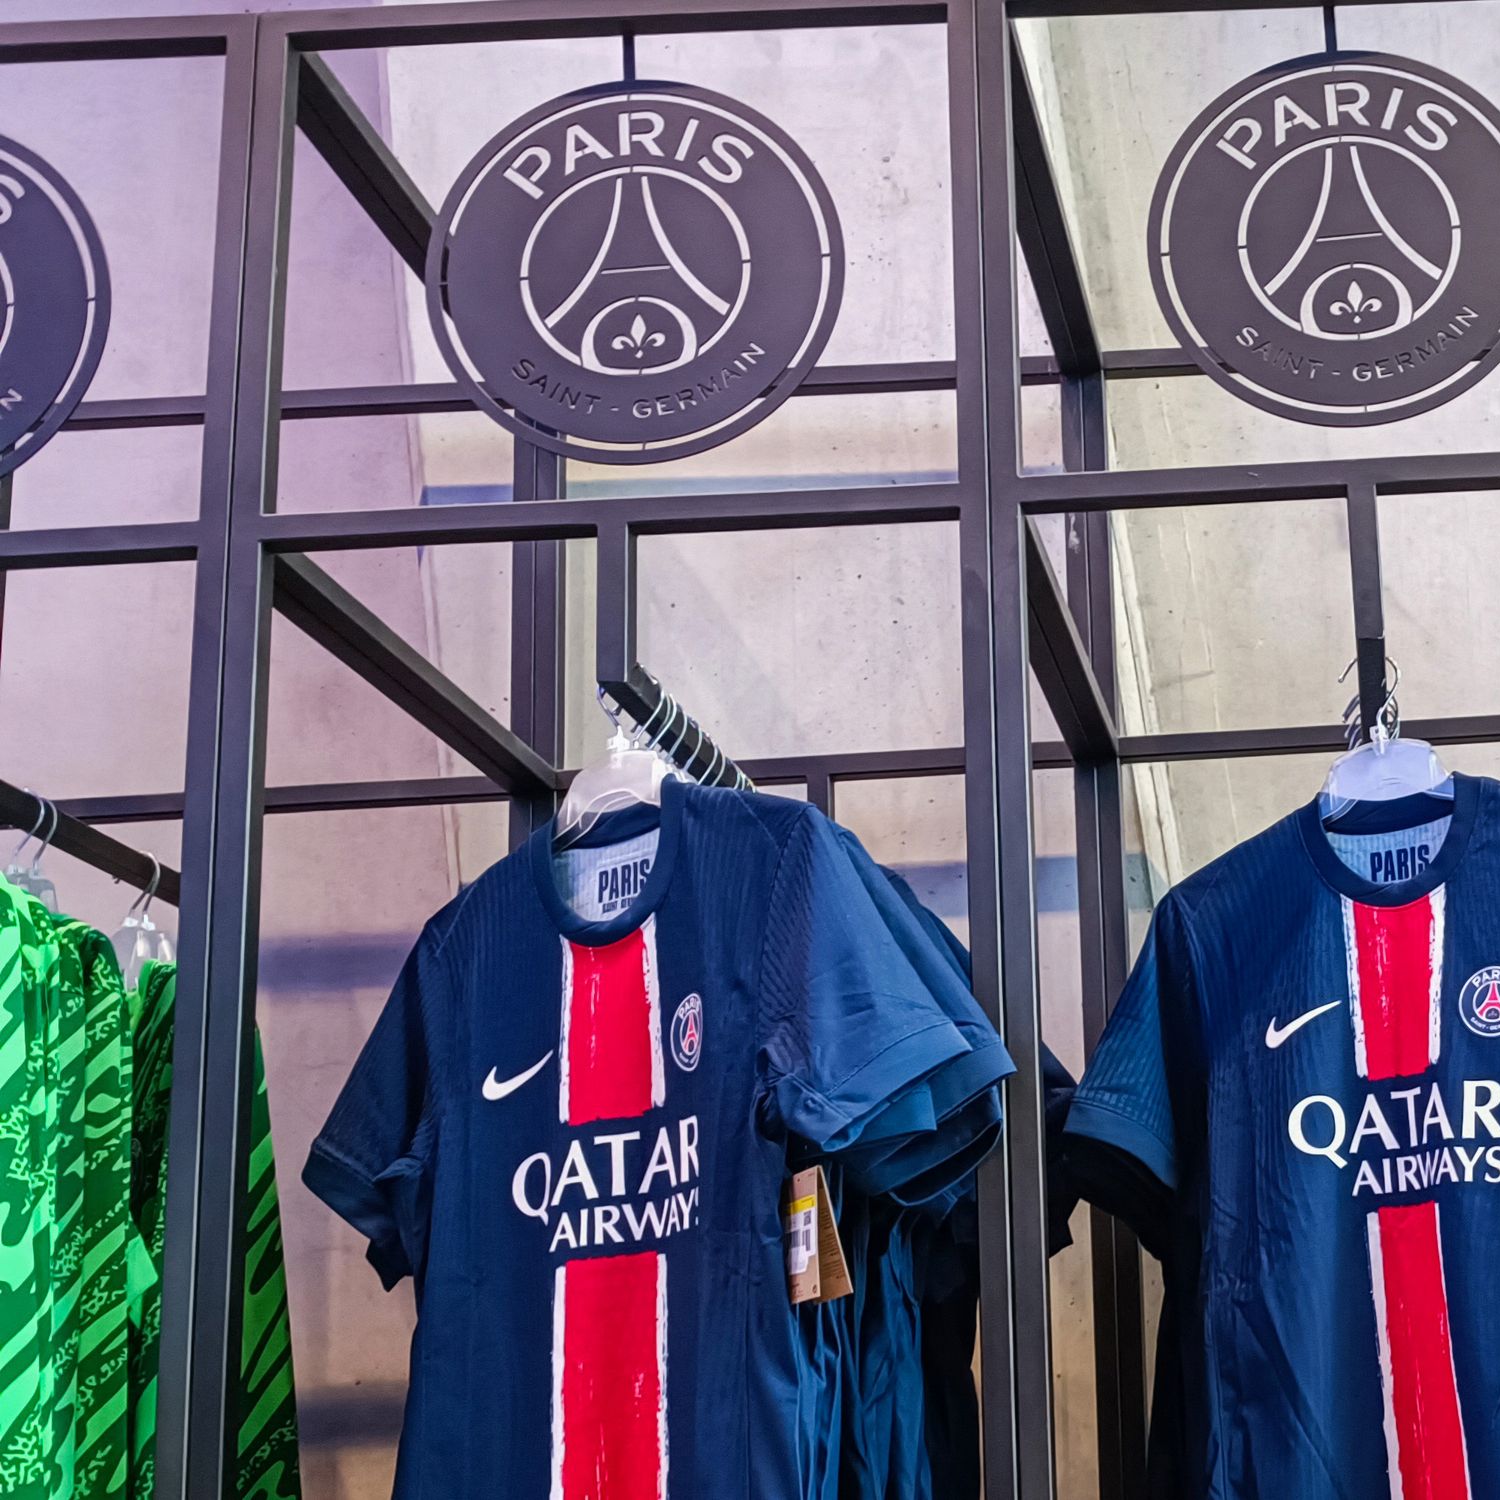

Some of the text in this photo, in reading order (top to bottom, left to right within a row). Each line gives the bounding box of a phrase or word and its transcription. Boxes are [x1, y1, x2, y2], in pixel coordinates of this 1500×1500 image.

[503, 111, 754, 200] PARIS
[1216, 80, 1458, 170] PARIS
[512, 358, 601, 415] SAINT
[632, 342, 766, 419] GERMAIN
[1235, 326, 1324, 379] SAINT
[1352, 305, 1479, 382] GERMAIN
[1370, 844, 1430, 882] PARIS
[512, 1115, 699, 1225] QATAR
[549, 1186, 699, 1253] AIRWAY
